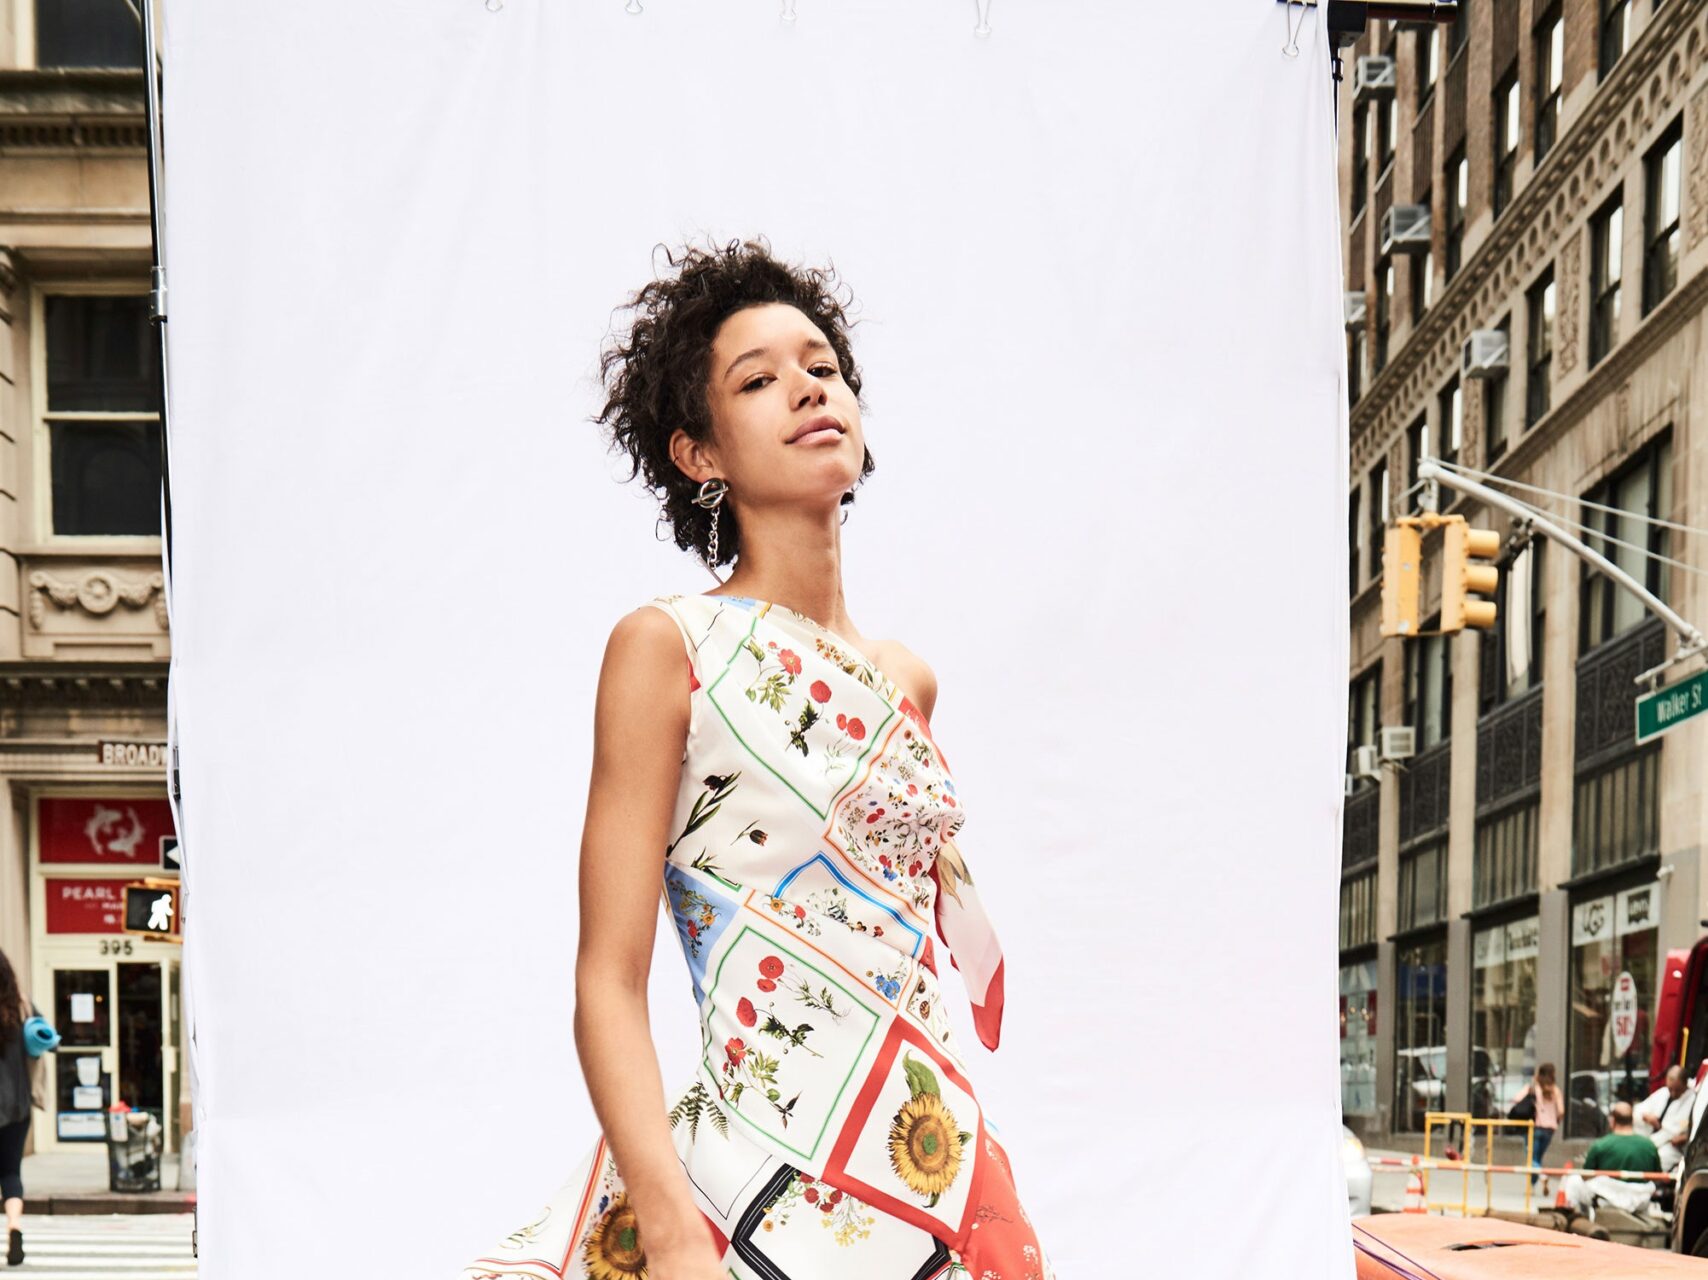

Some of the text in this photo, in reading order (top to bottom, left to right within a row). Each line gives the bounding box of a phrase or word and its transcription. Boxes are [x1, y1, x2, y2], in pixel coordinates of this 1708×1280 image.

[1656, 683, 1702, 723] Walker St
[62, 886, 115, 900] PEARL
[100, 939, 133, 956] 395
